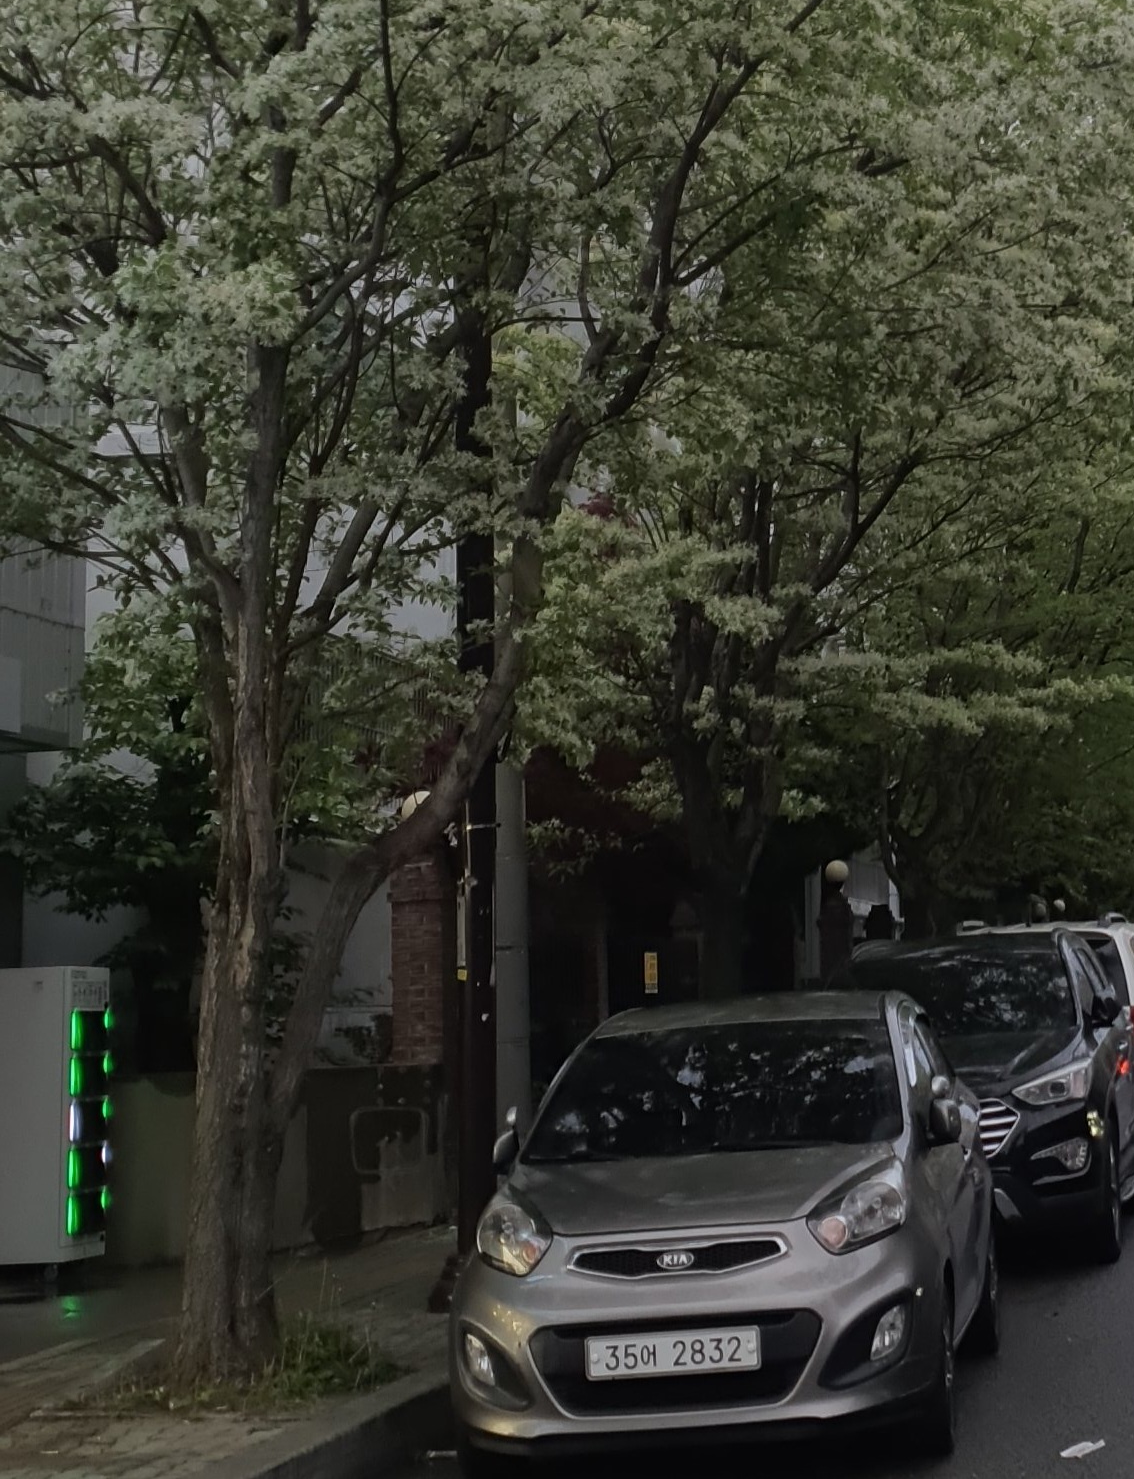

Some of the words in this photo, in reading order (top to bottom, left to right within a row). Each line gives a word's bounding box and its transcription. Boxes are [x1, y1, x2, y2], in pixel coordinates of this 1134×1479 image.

[661, 1253, 690, 1267] KIA
[605, 1343, 658, 1371] 35어
[672, 1336, 742, 1367] 2832
